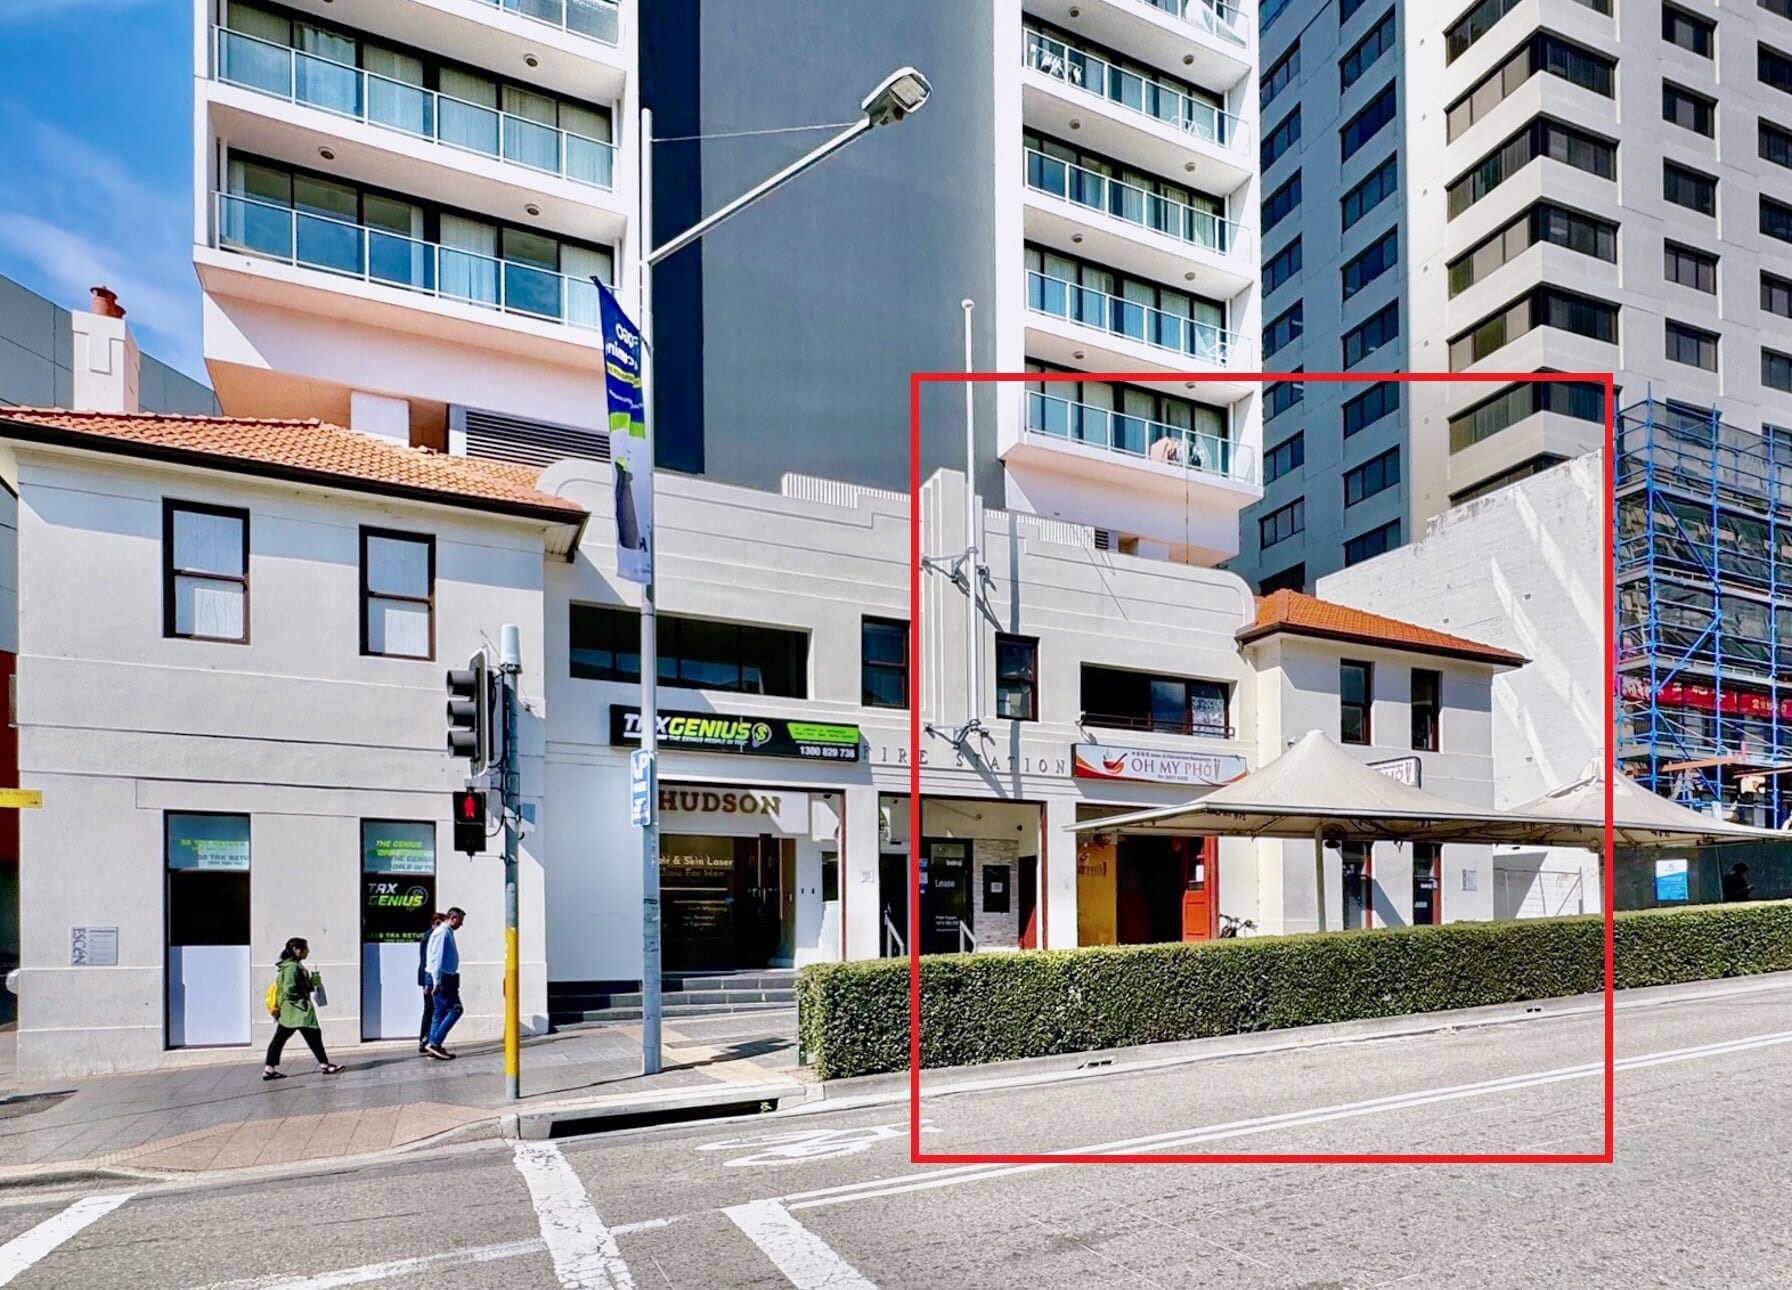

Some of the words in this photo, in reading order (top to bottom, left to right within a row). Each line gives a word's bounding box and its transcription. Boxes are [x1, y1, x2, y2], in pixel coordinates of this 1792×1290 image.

[863, 745, 928, 764] FIRE
[956, 752, 1066, 774] STATION
[1131, 758, 1154, 772] OH
[1159, 761, 1180, 775] MY
[659, 790, 781, 817] HUDSON
[683, 856, 704, 866] Skin
[707, 857, 733, 866] Laser
[368, 883, 398, 894] TAX
[368, 896, 423, 907] GENIUS
